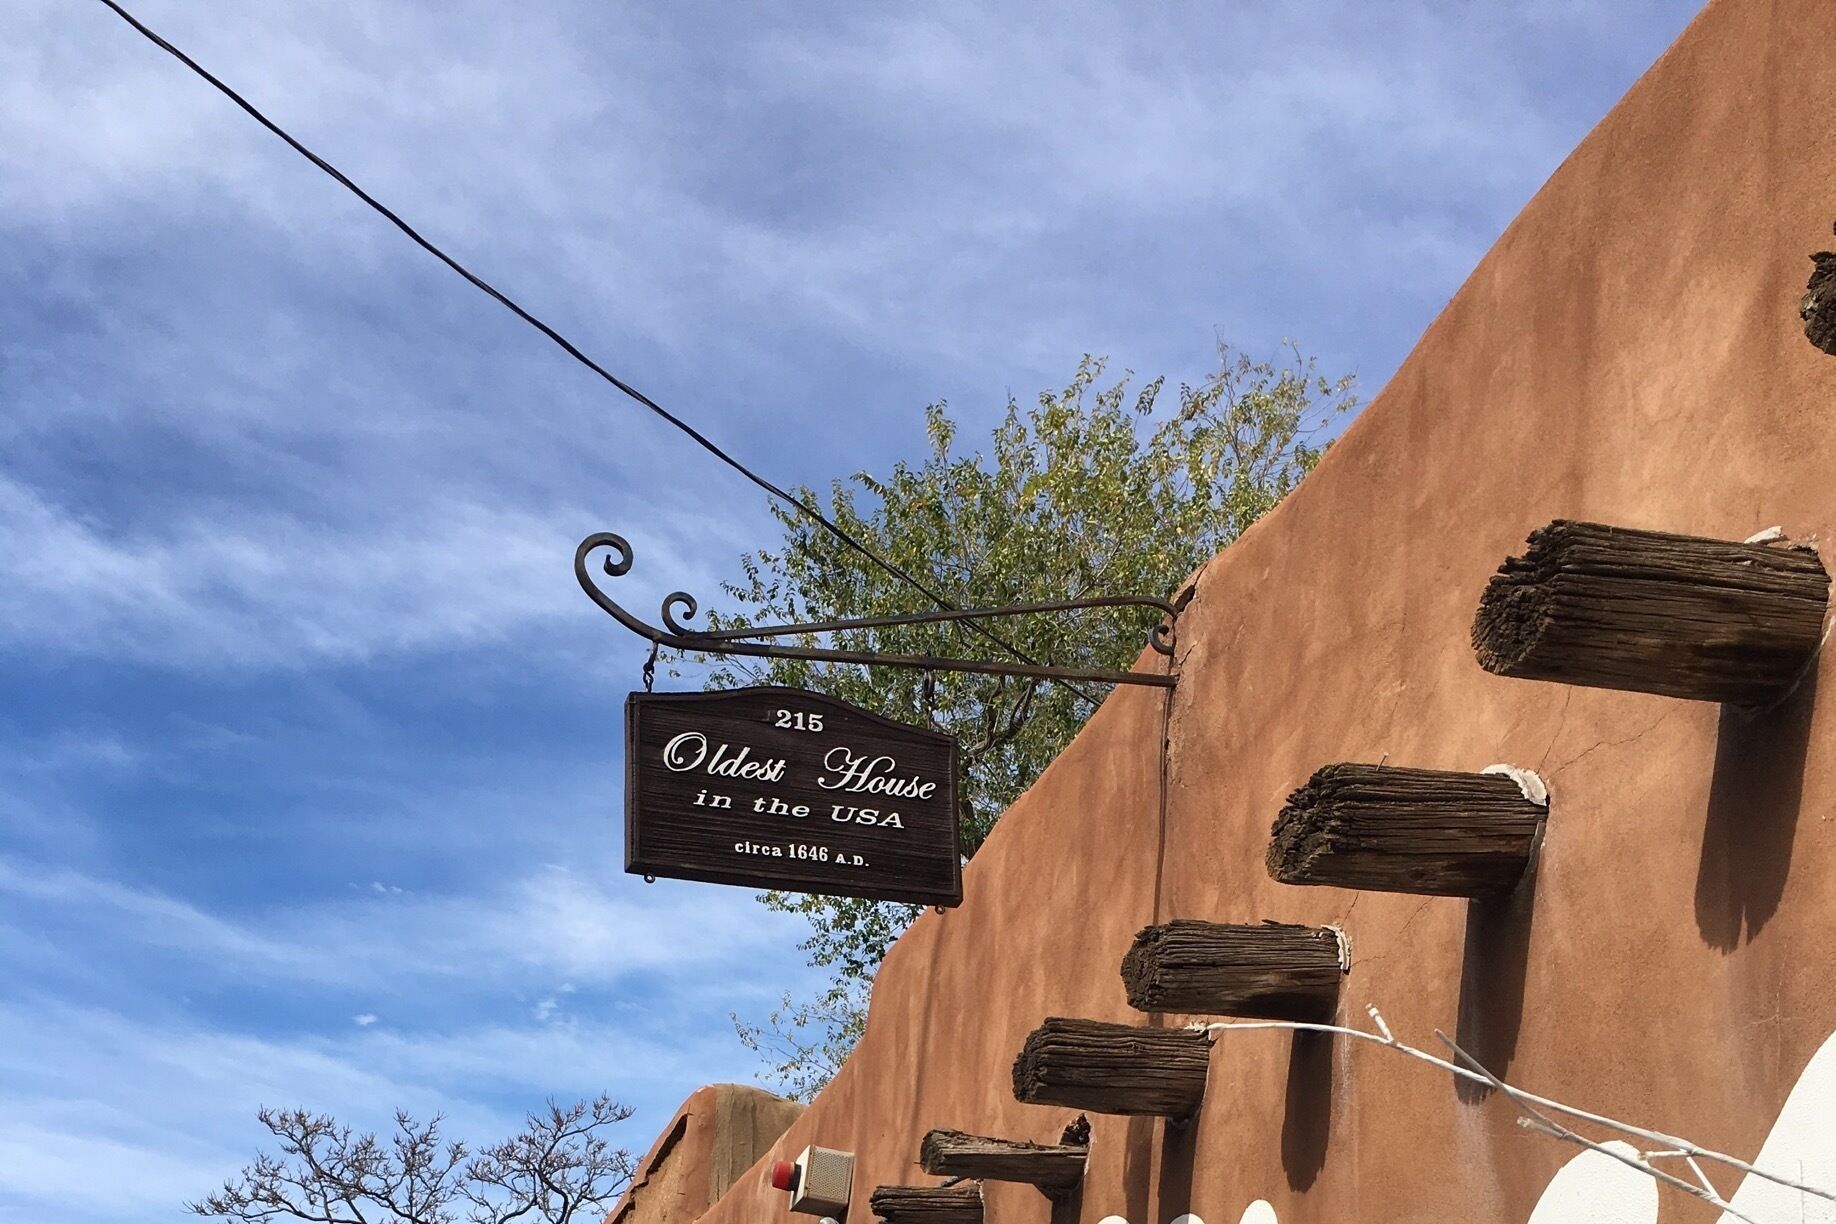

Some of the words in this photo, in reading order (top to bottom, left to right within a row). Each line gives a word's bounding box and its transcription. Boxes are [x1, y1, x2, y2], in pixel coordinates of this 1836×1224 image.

[774, 709, 824, 733] 215
[663, 731, 787, 783] Oldest
[817, 747, 938, 800] House
[693, 789, 732, 809] in
[753, 797, 811, 818] the
[831, 805, 905, 829] USA
[734, 841, 783, 858] circa
[788, 843, 829, 862] 1646
[835, 853, 870, 867] A.D.
